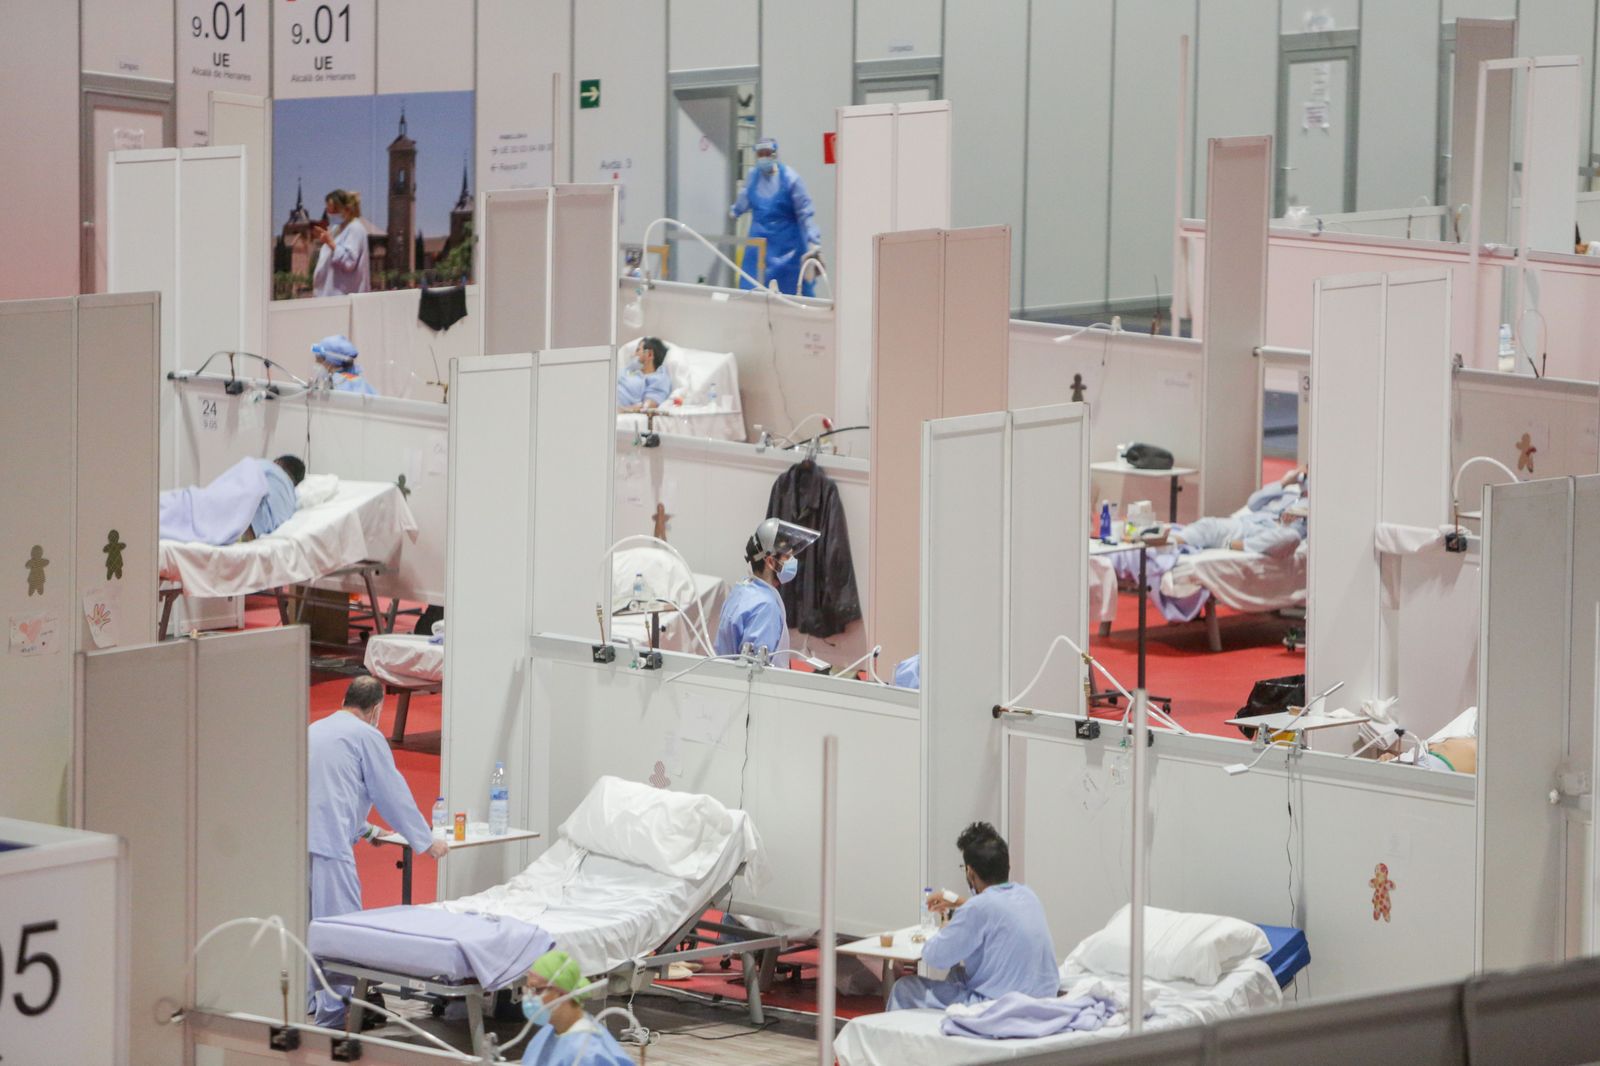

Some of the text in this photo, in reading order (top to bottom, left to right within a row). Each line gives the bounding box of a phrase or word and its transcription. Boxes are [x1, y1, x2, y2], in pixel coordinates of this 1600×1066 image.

[191, 1, 246, 42] 9.01
[291, 4, 350, 45] 9.01
[213, 52, 230, 68] UE
[314, 55, 333, 71] UE
[202, 399, 217, 416] 24
